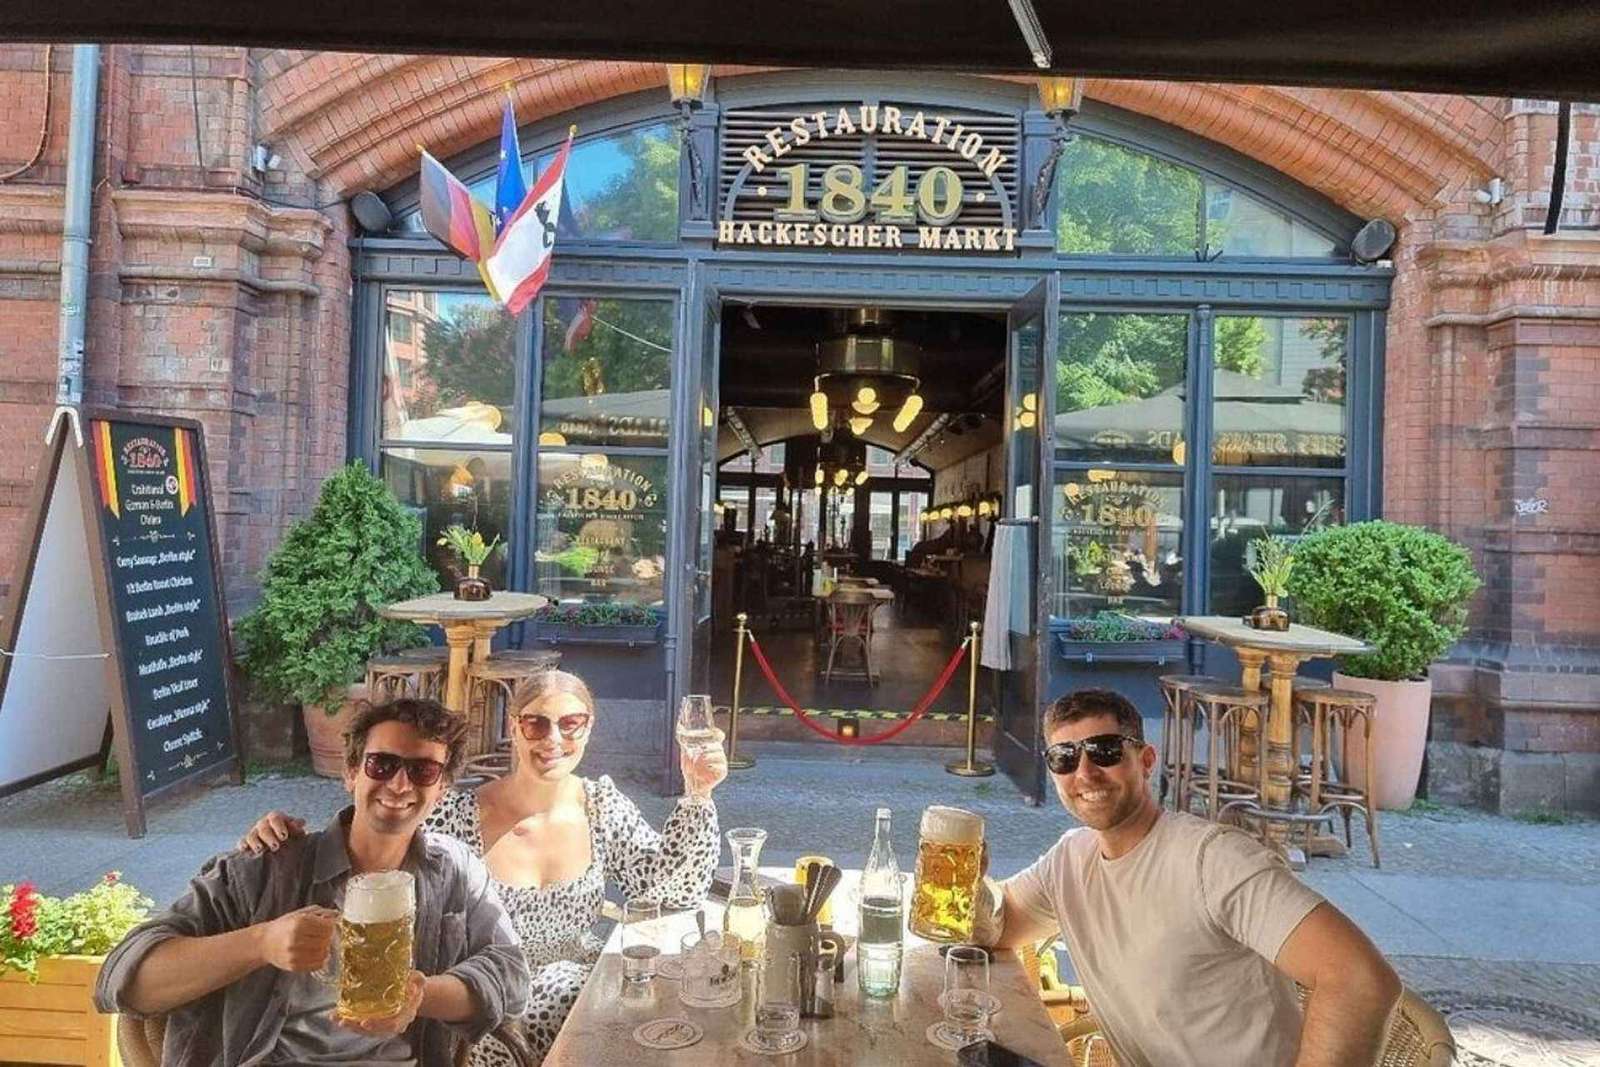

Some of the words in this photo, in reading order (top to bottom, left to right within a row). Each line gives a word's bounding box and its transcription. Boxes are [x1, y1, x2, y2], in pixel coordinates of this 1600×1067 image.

[742, 105, 1007, 178] RESTAURATION
[773, 162, 964, 226] 1840
[717, 219, 903, 248] HACKESCHER
[918, 226, 1017, 251] MARKT
[565, 487, 637, 511] 1840
